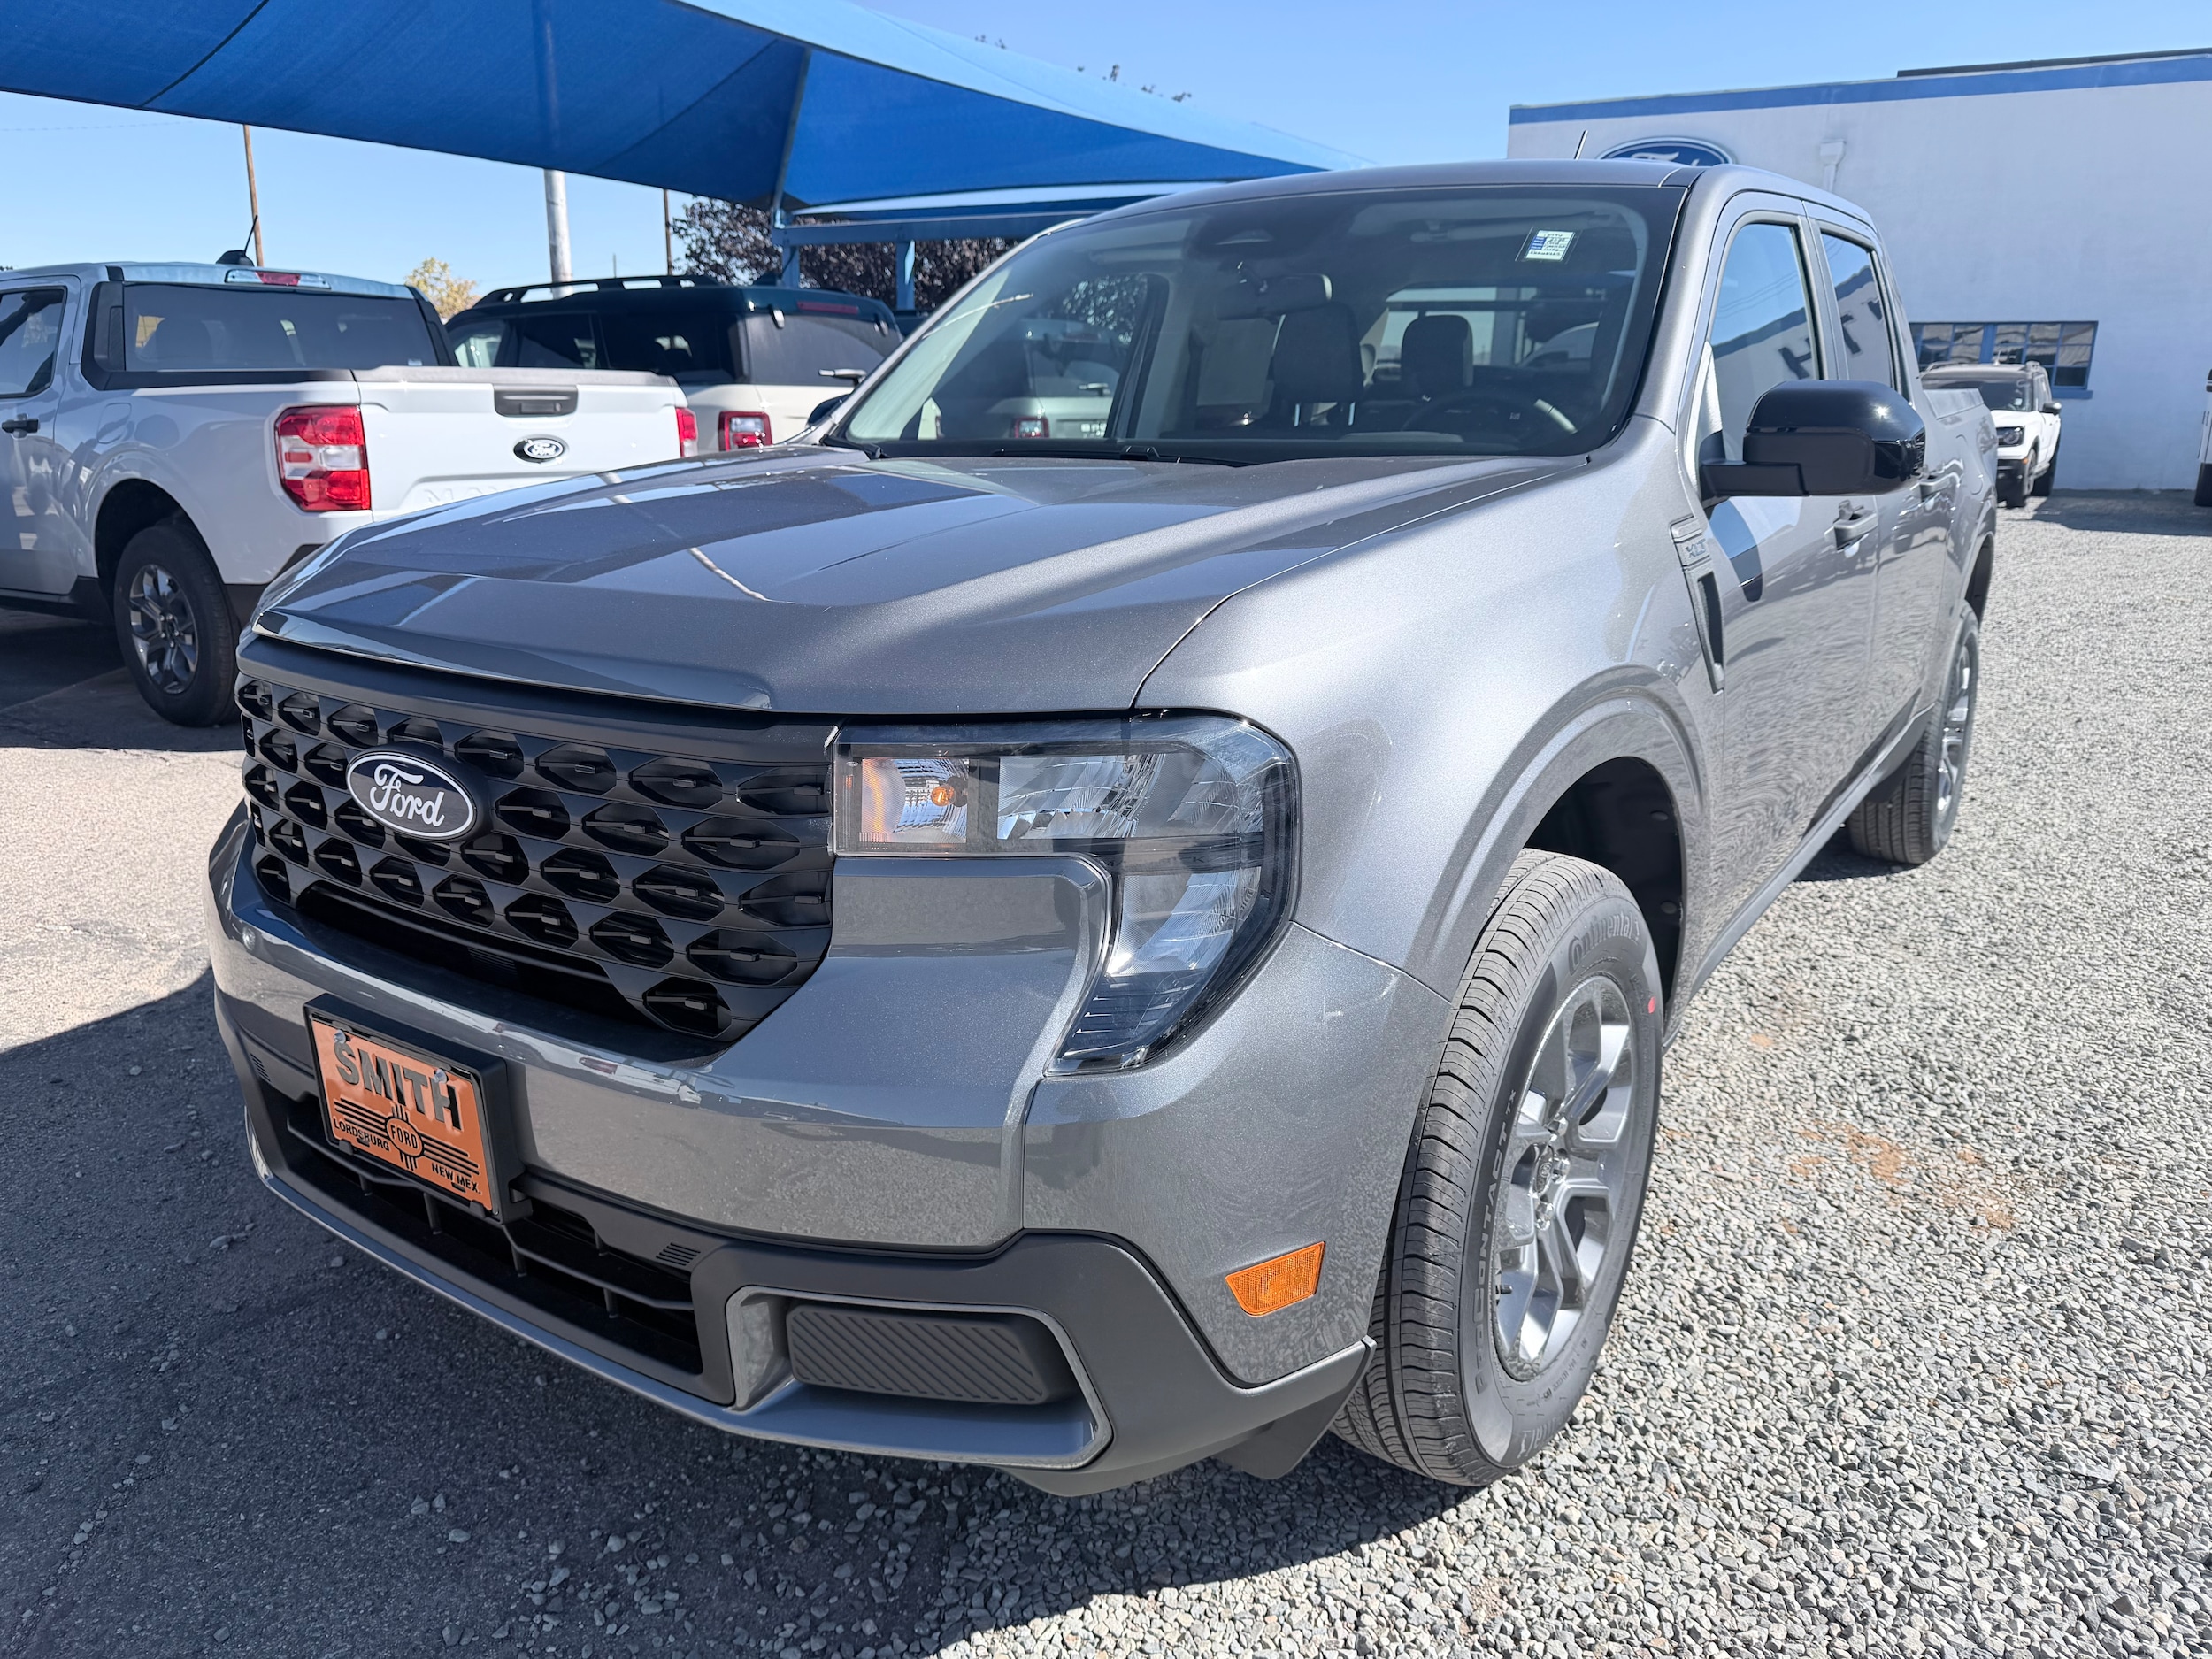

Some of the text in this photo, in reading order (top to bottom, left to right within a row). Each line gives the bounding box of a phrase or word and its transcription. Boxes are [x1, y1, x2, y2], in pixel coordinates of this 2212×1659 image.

[370, 764, 445, 827] Ford
[1568, 910, 1633, 976] Continental
[333, 1041, 464, 1133] SMITH
[334, 1118, 390, 1152] LORDSBURG
[390, 1124, 419, 1150] FORD
[431, 1162, 481, 1195] NEW MEX.
